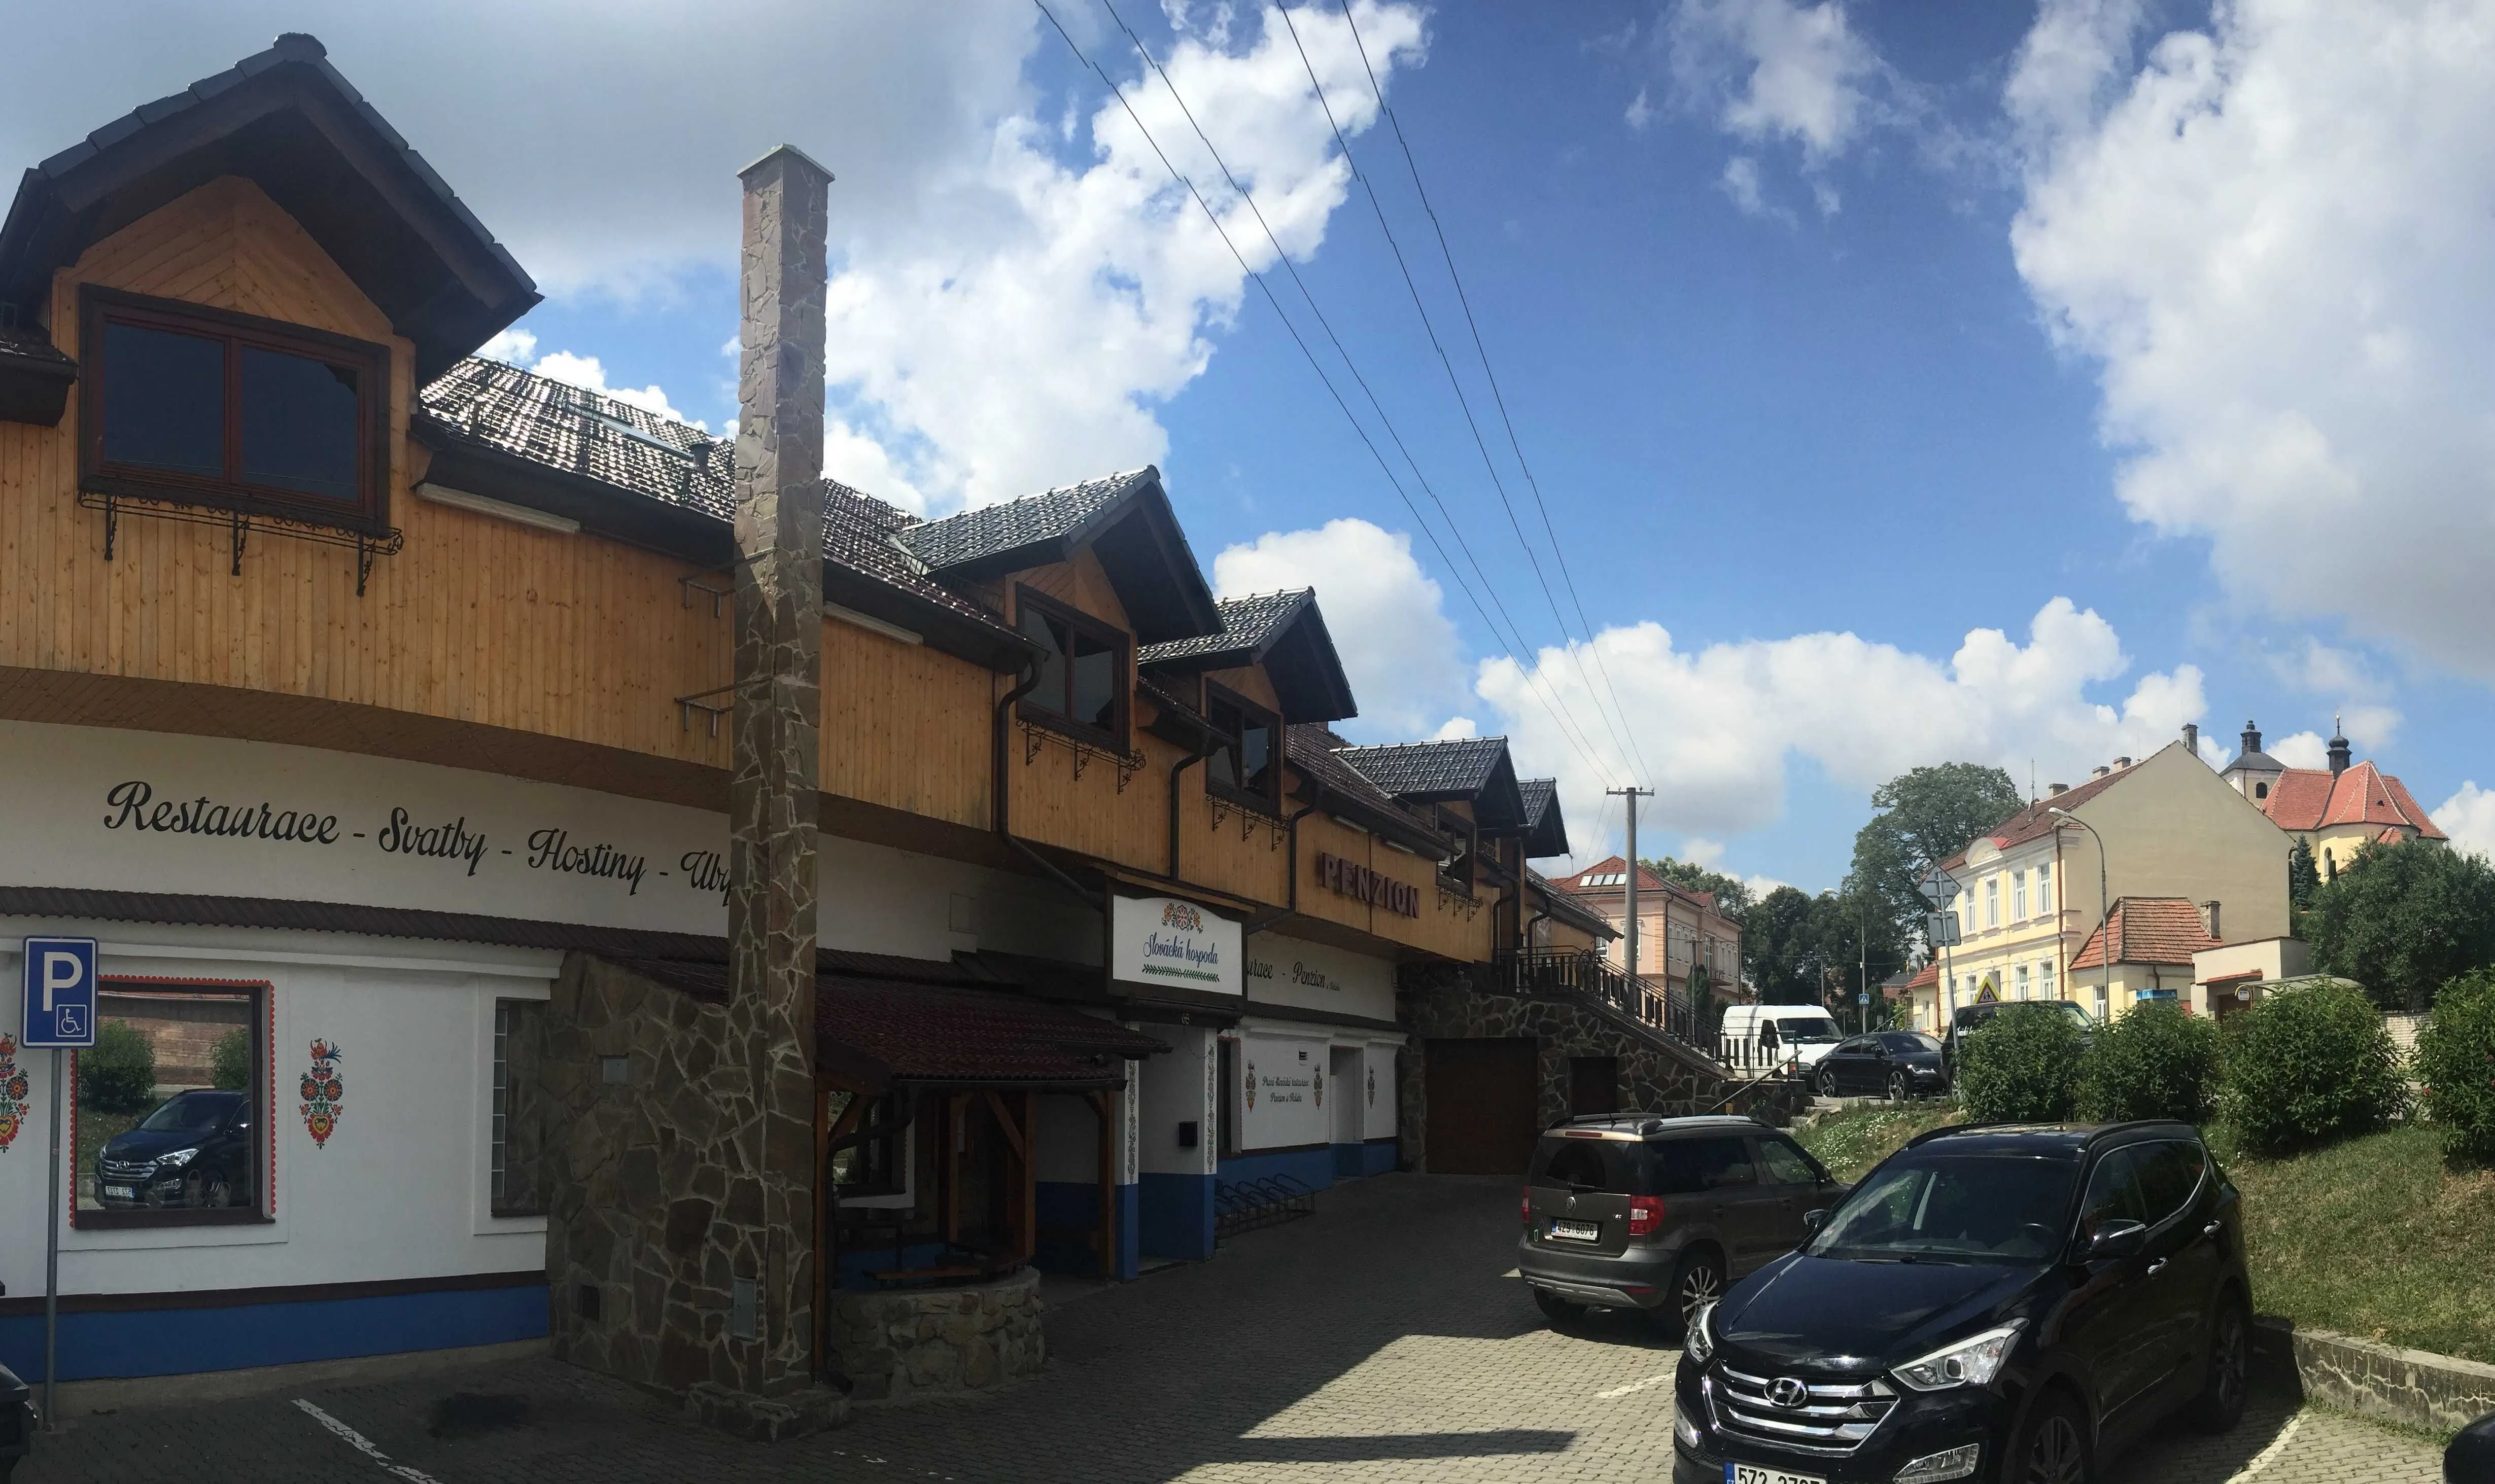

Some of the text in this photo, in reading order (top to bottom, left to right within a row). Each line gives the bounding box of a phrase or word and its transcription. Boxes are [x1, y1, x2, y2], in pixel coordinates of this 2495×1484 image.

[103, 781, 339, 844] Restaurace
[378, 807, 488, 877] Svatby
[528, 828, 647, 896] Hostiny
[1322, 852, 1420, 918] PENZION
[1143, 932, 1219, 968] Slovácká hospoda
[44, 951, 83, 1011] P
[1292, 962, 1326, 988] Penzion
[1557, 1221, 1571, 1233] 4Z9
[1576, 1224, 1594, 1235] 6076
